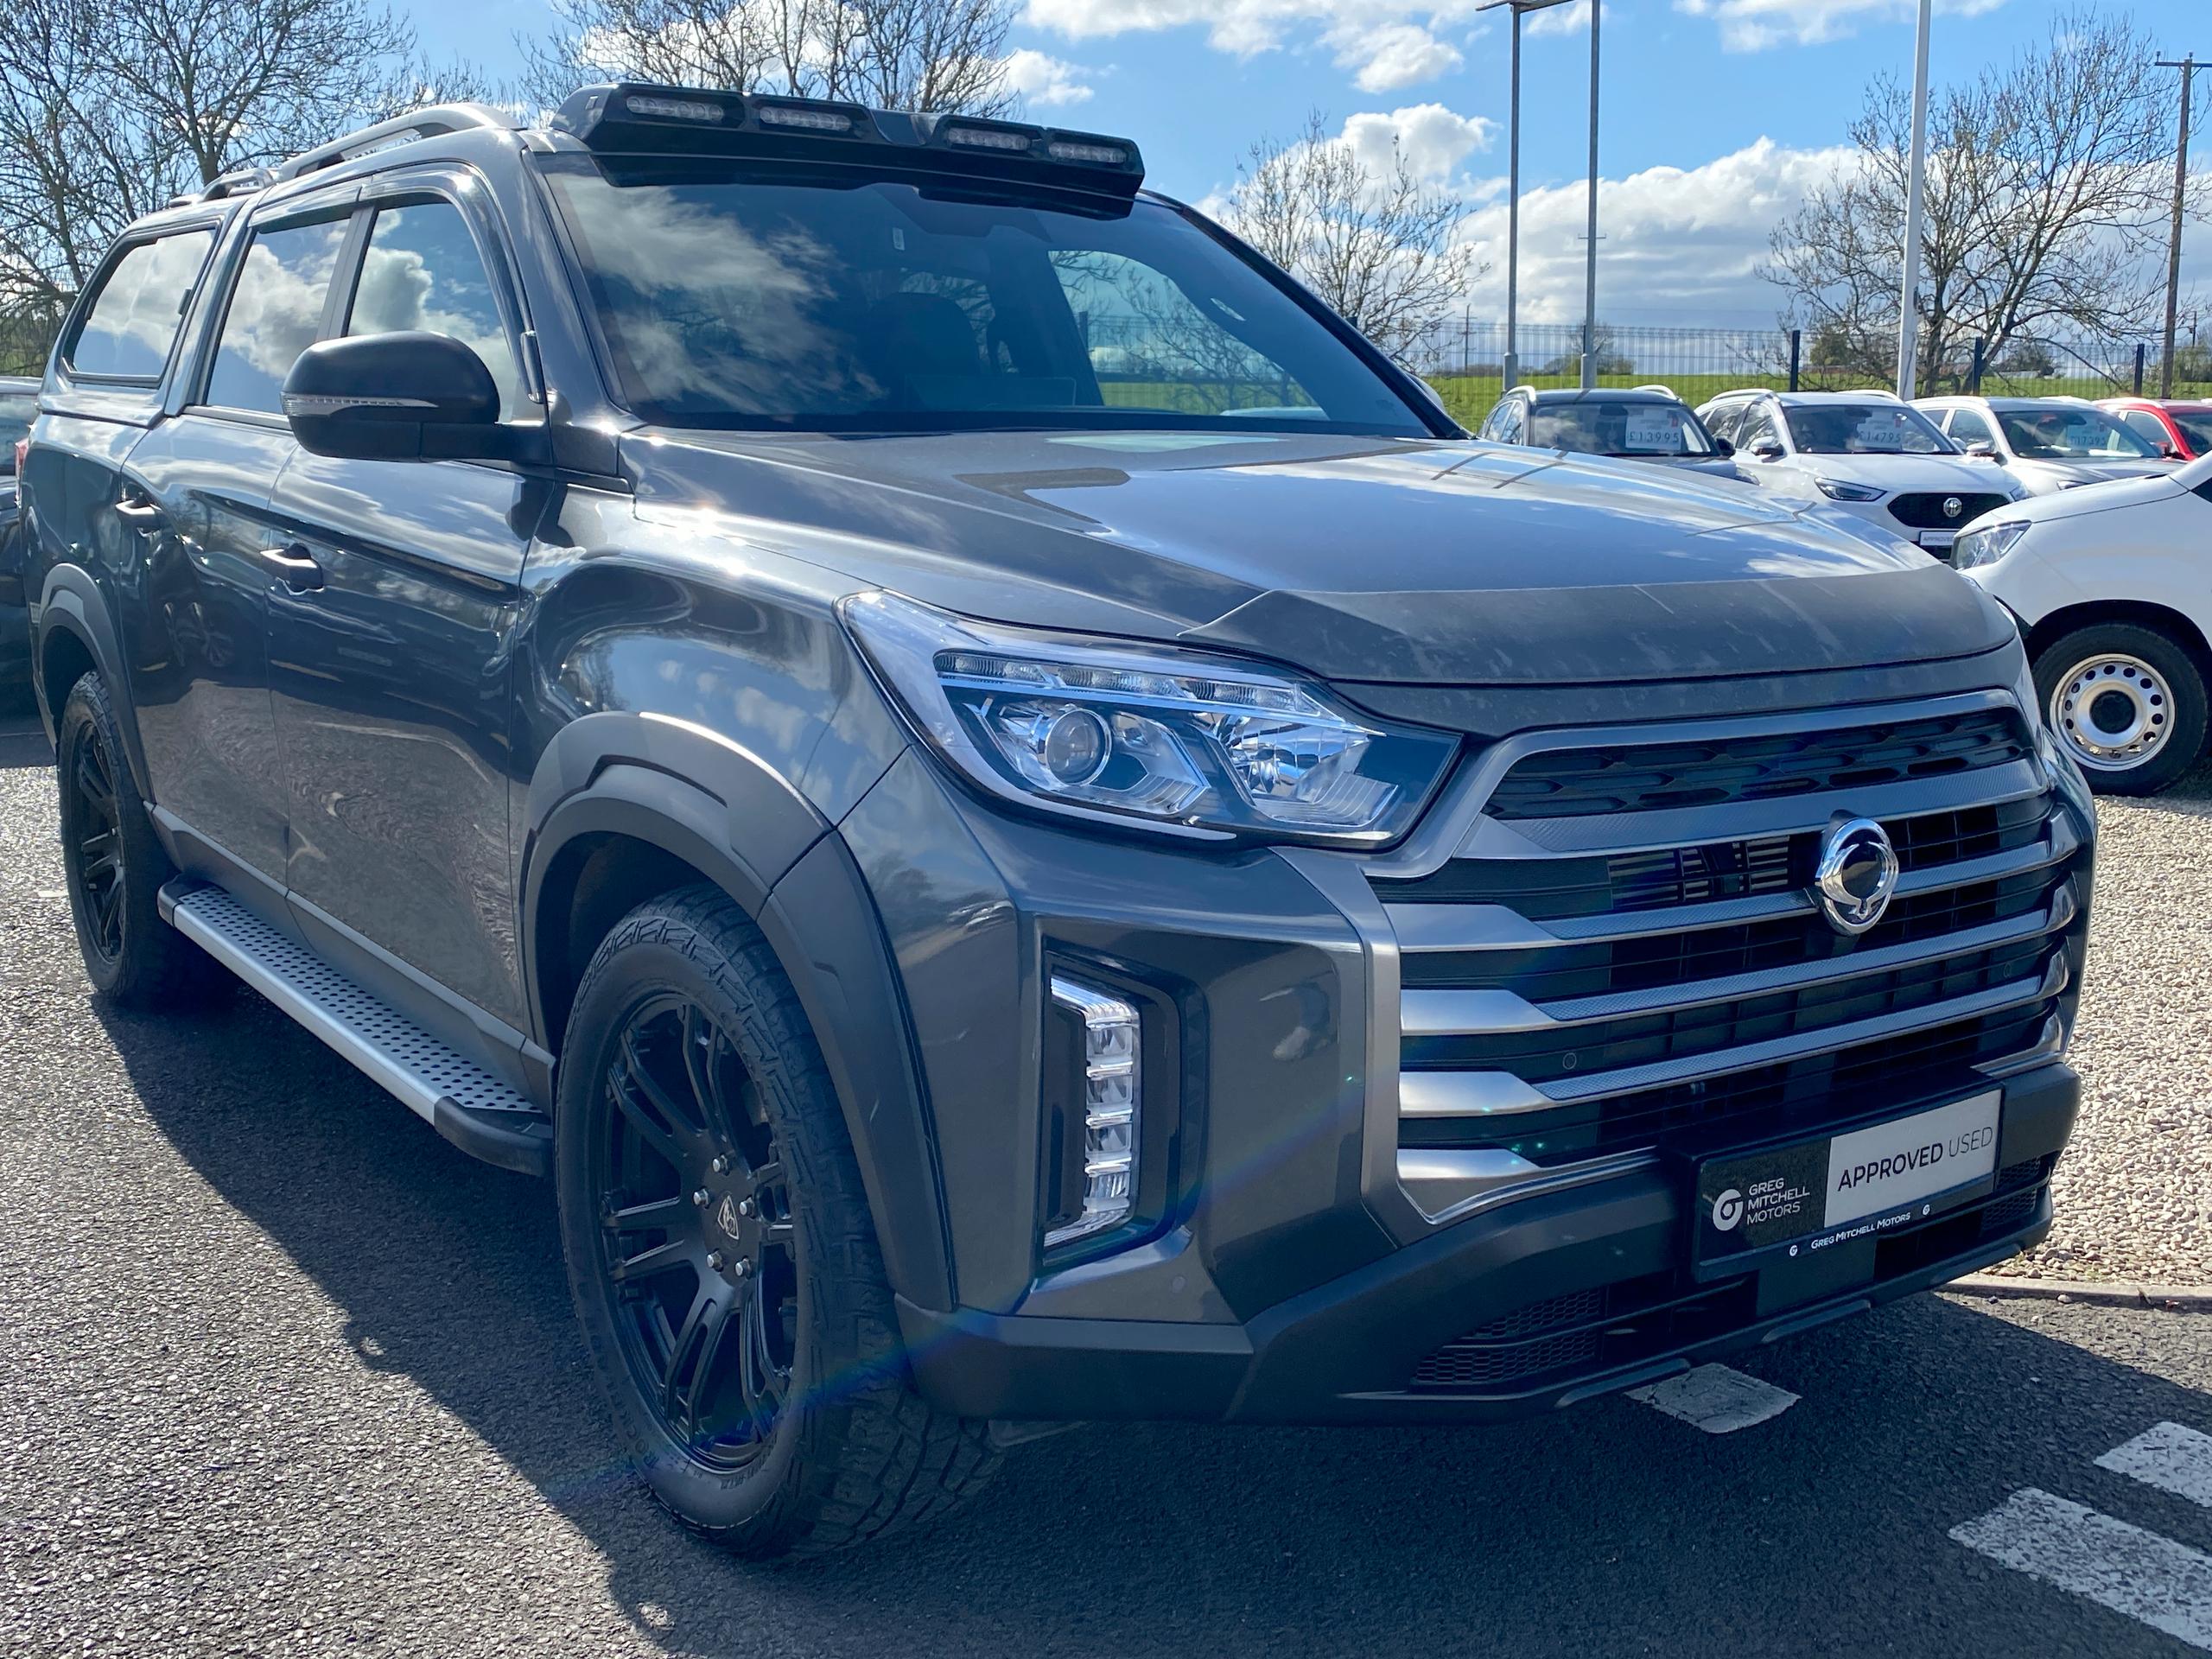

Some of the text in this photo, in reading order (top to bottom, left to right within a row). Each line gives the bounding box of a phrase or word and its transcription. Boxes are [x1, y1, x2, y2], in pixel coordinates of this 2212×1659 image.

[1629, 430, 1680, 443] £13995
[1837, 1126, 1993, 1192] APPROVED USED
[1747, 1185, 1810, 1211] MITCHELL
[1748, 1177, 1784, 1196] GREG
[1746, 1201, 1801, 1225] MOTORS
